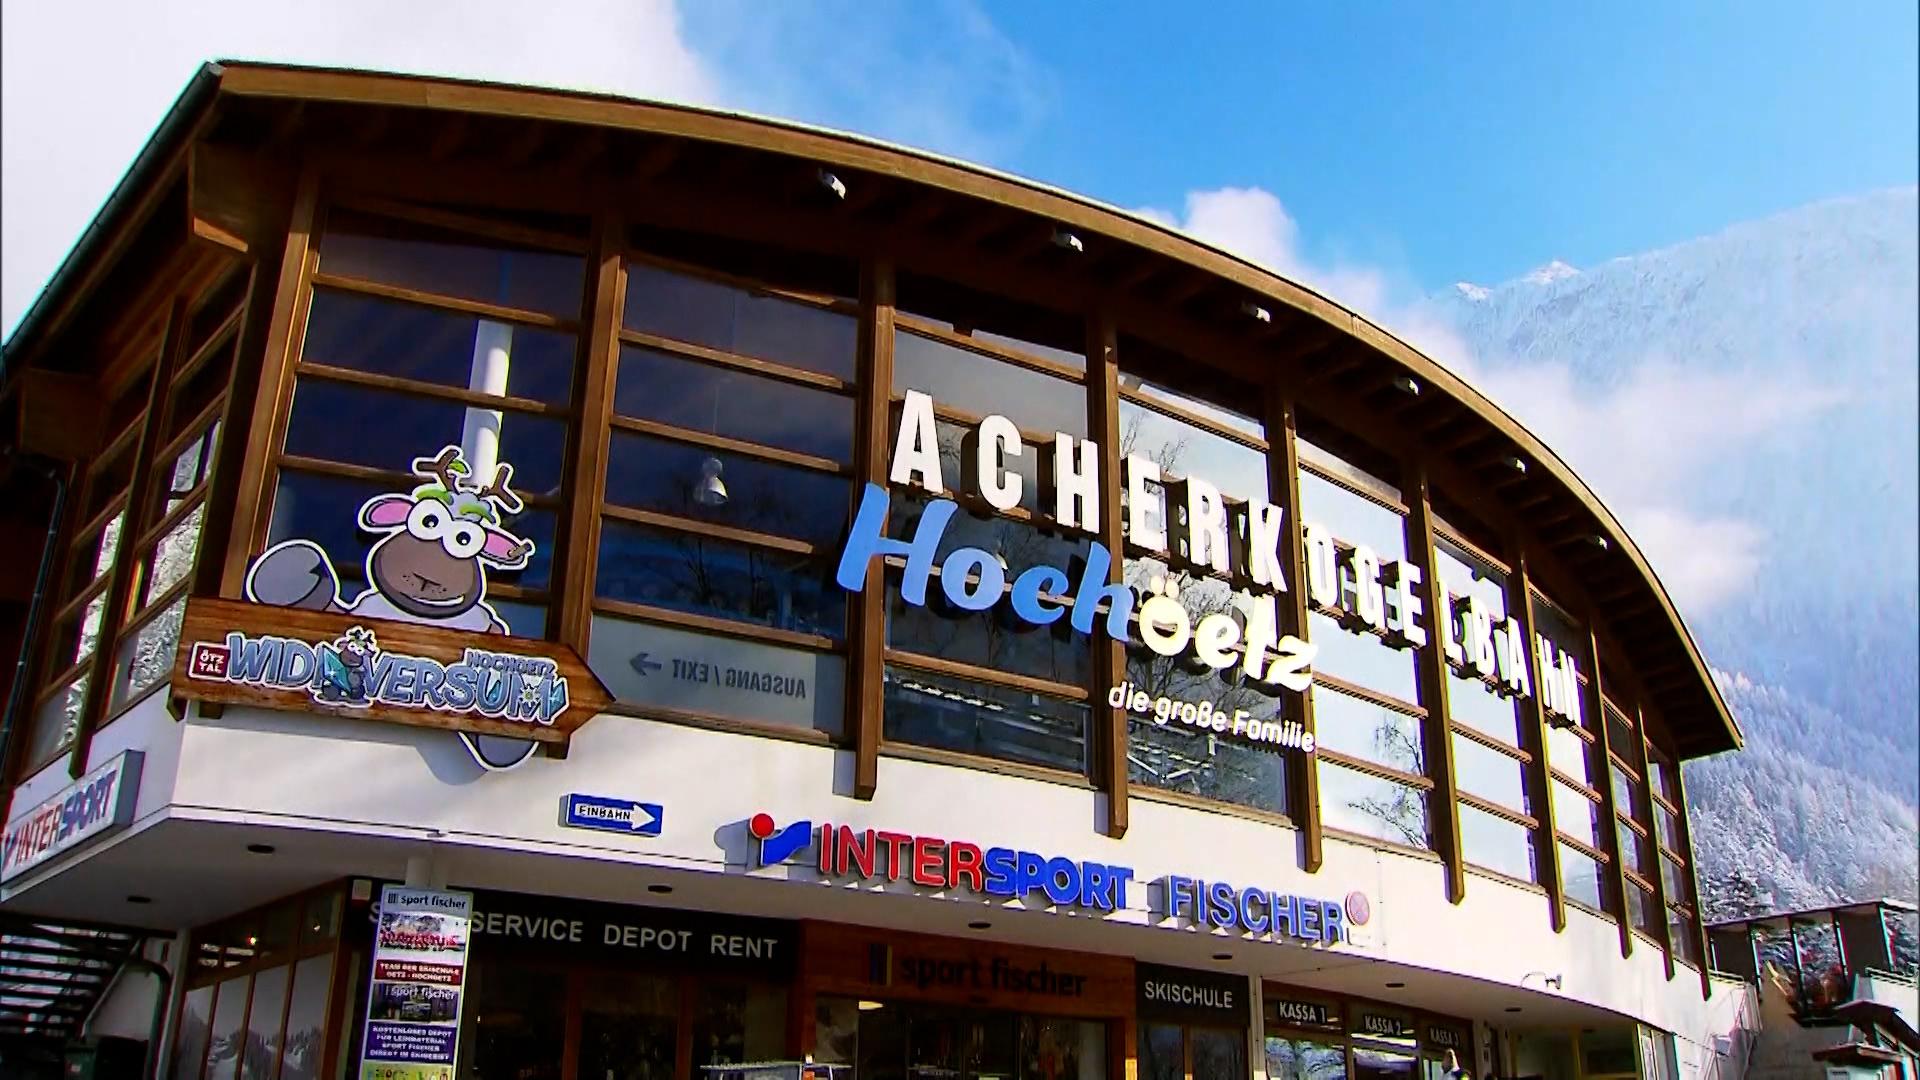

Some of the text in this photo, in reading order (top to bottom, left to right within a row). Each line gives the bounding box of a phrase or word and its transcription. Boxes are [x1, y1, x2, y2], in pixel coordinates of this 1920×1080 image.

[200, 663, 223, 674] TAL
[1108, 681, 1315, 752] die große Familie
[15, 770, 117, 866] INTERSPORT
[579, 804, 631, 821] EINBAHN
[819, 823, 1344, 941] INTERSPORT FISCHER
[401, 895, 466, 909] sport fischer
[470, 910, 583, 942] SERVICE
[603, 924, 692, 951] DEPOT
[710, 935, 778, 959] RENT
[902, 956, 1087, 997] sport fischer
[391, 984, 454, 1000] sport fischer
[1145, 981, 1233, 1009] SKISCHULE
[1279, 1001, 1326, 1023] KASSA 1
[1365, 1015, 1402, 1036] KASSA 2
[1430, 1027, 1452, 1045] KASSA
